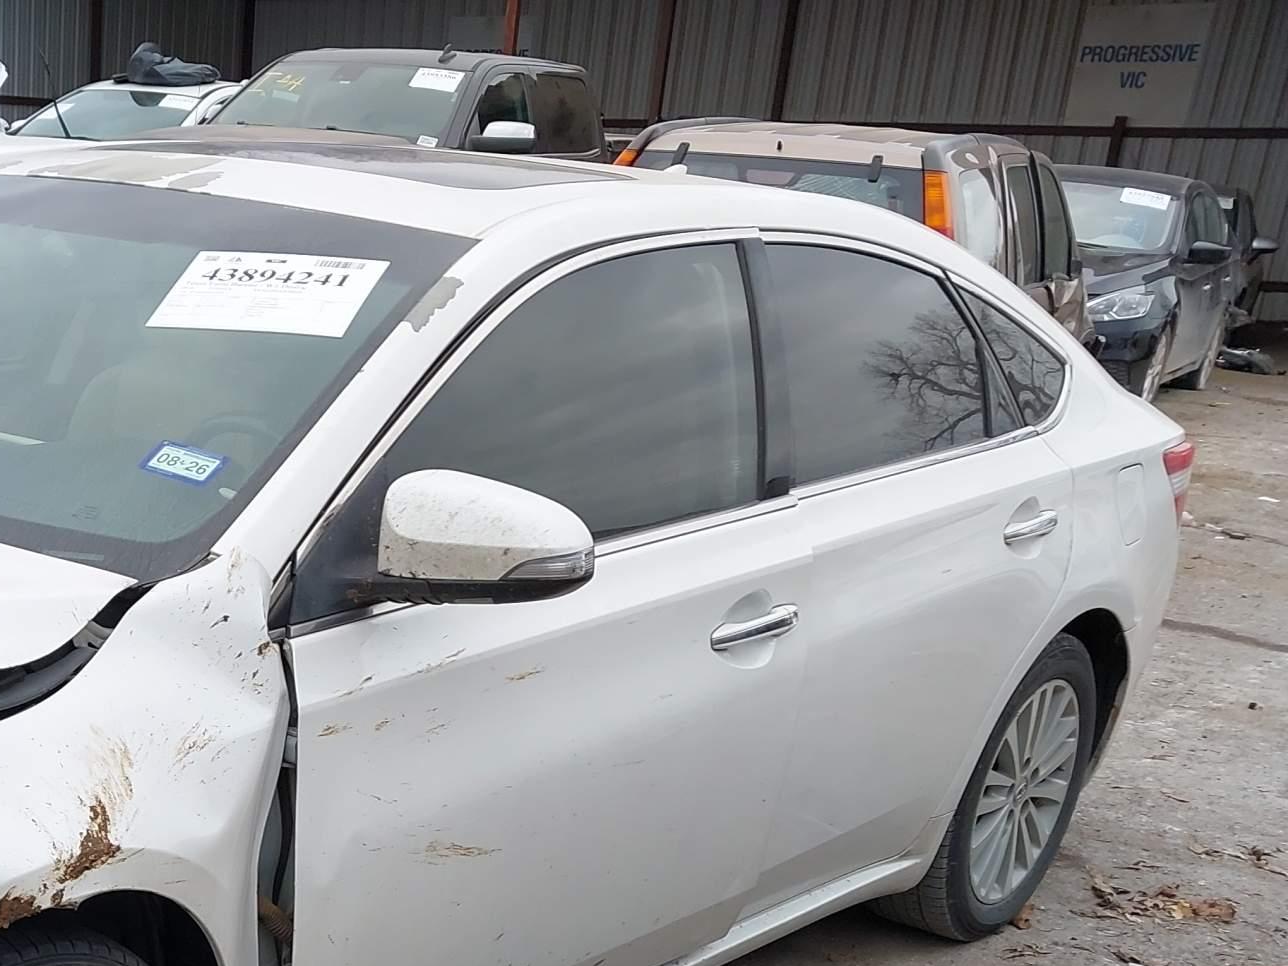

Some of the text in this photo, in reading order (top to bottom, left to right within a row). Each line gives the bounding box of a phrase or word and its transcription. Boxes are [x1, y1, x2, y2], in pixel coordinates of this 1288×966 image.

[1079, 44, 1201, 63] PROGRESSIVE
[1119, 71, 1147, 88] VIC
[201, 267, 350, 287] 43894241
